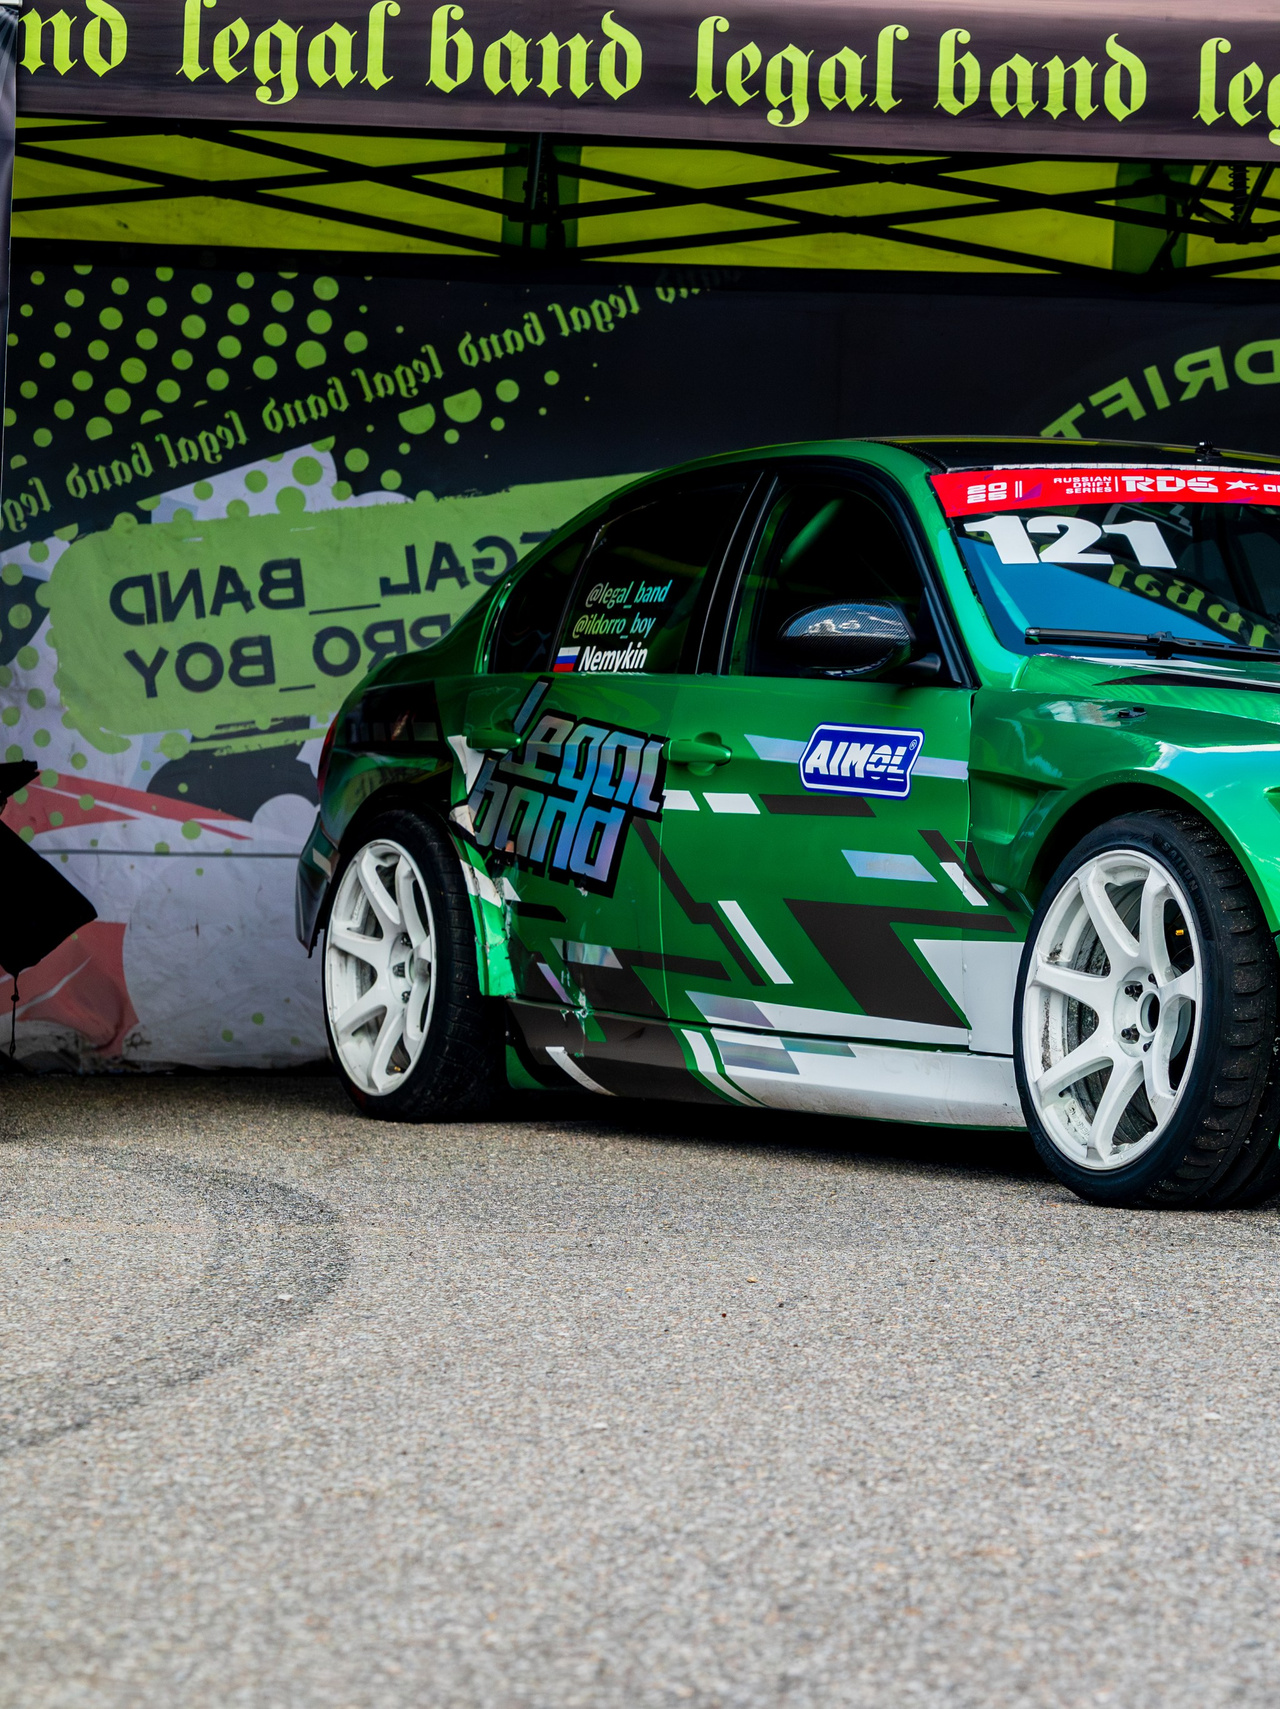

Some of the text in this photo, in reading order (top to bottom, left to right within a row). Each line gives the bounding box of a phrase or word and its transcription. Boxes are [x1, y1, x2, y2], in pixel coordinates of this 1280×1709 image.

[175, 0, 401, 104] legal
[425, 4, 643, 100] band
[690, 16, 909, 127] legal
[934, 28, 1147, 122] band
[1053, 476, 1112, 484] RUSSIAN
[1065, 487, 1112, 495] SERIES
[1121, 476, 1219, 493] RDS
[963, 515, 1177, 568] 121
[585, 579, 673, 609] @legal_band
[578, 641, 648, 673] Nemykin
[805, 740, 908, 782] AIMOL
